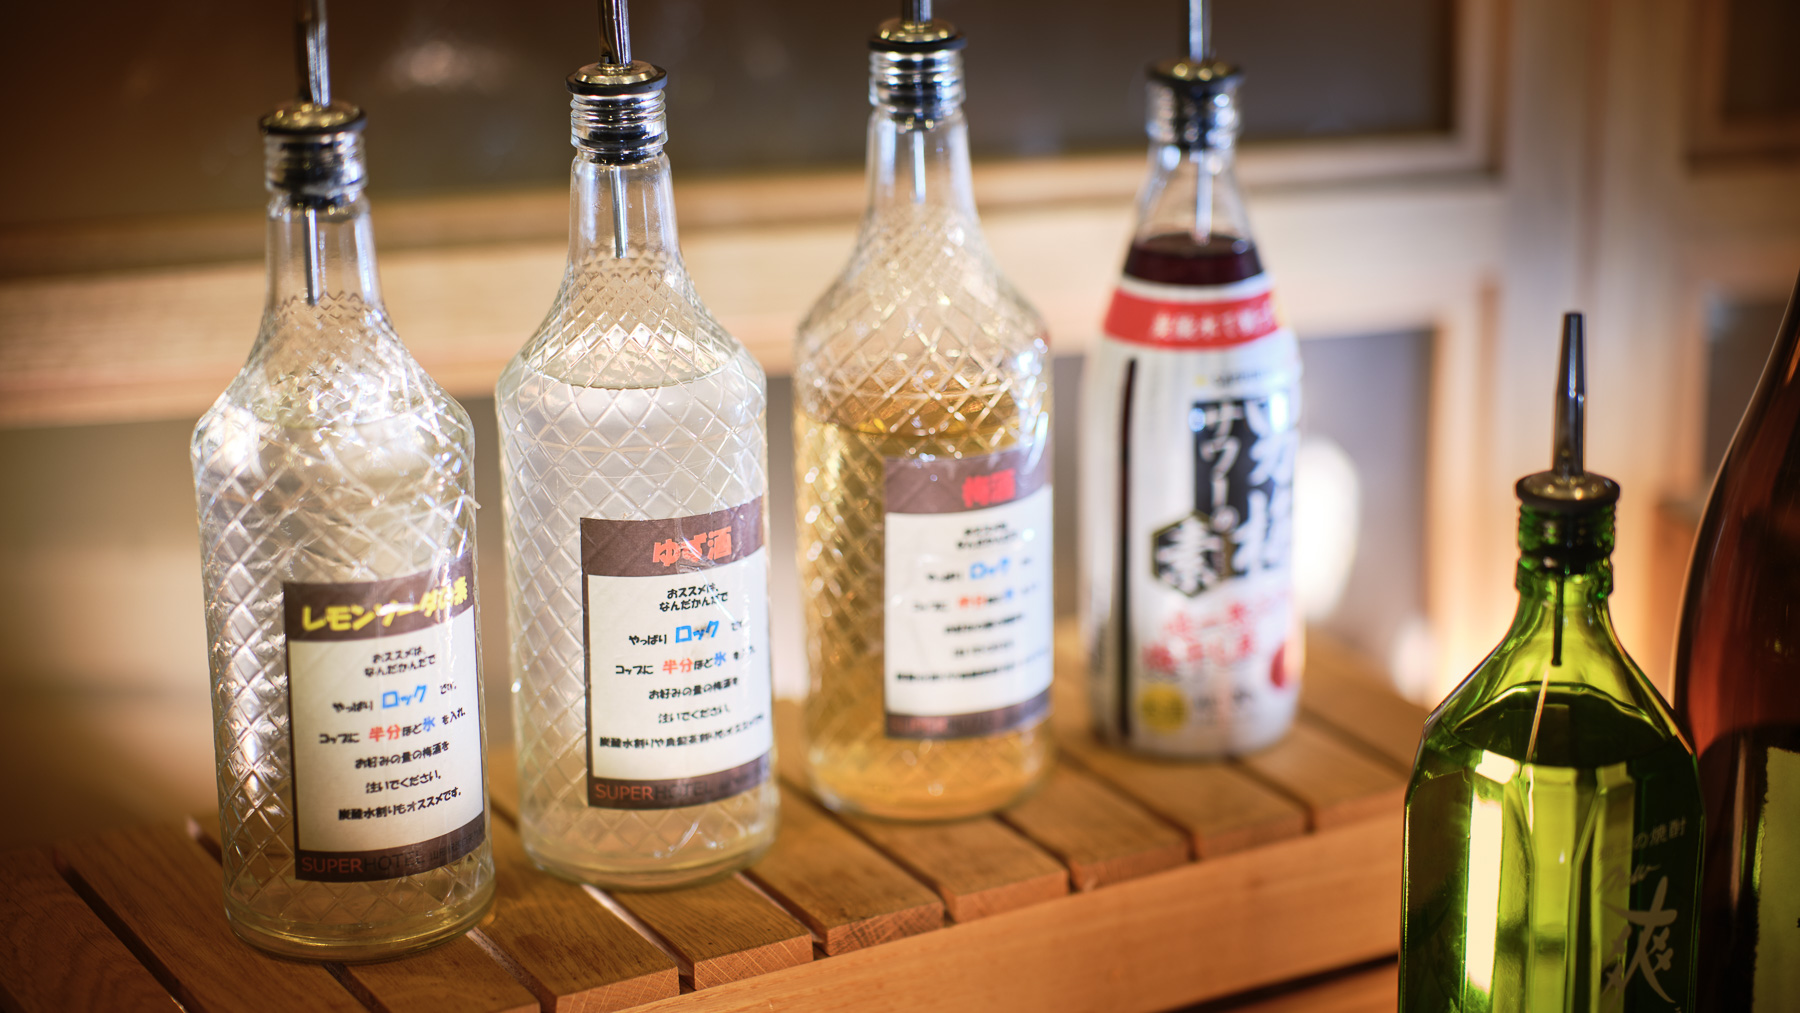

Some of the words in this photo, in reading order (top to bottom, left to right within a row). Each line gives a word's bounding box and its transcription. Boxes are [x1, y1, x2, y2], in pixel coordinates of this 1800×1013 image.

[652, 526, 732, 567] ゆず酒
[675, 620, 719, 643] ロック
[364, 654, 436, 677] なんだかんだで
[382, 684, 427, 709] ロック
[355, 740, 450, 769] お好みの量の梅酒を
